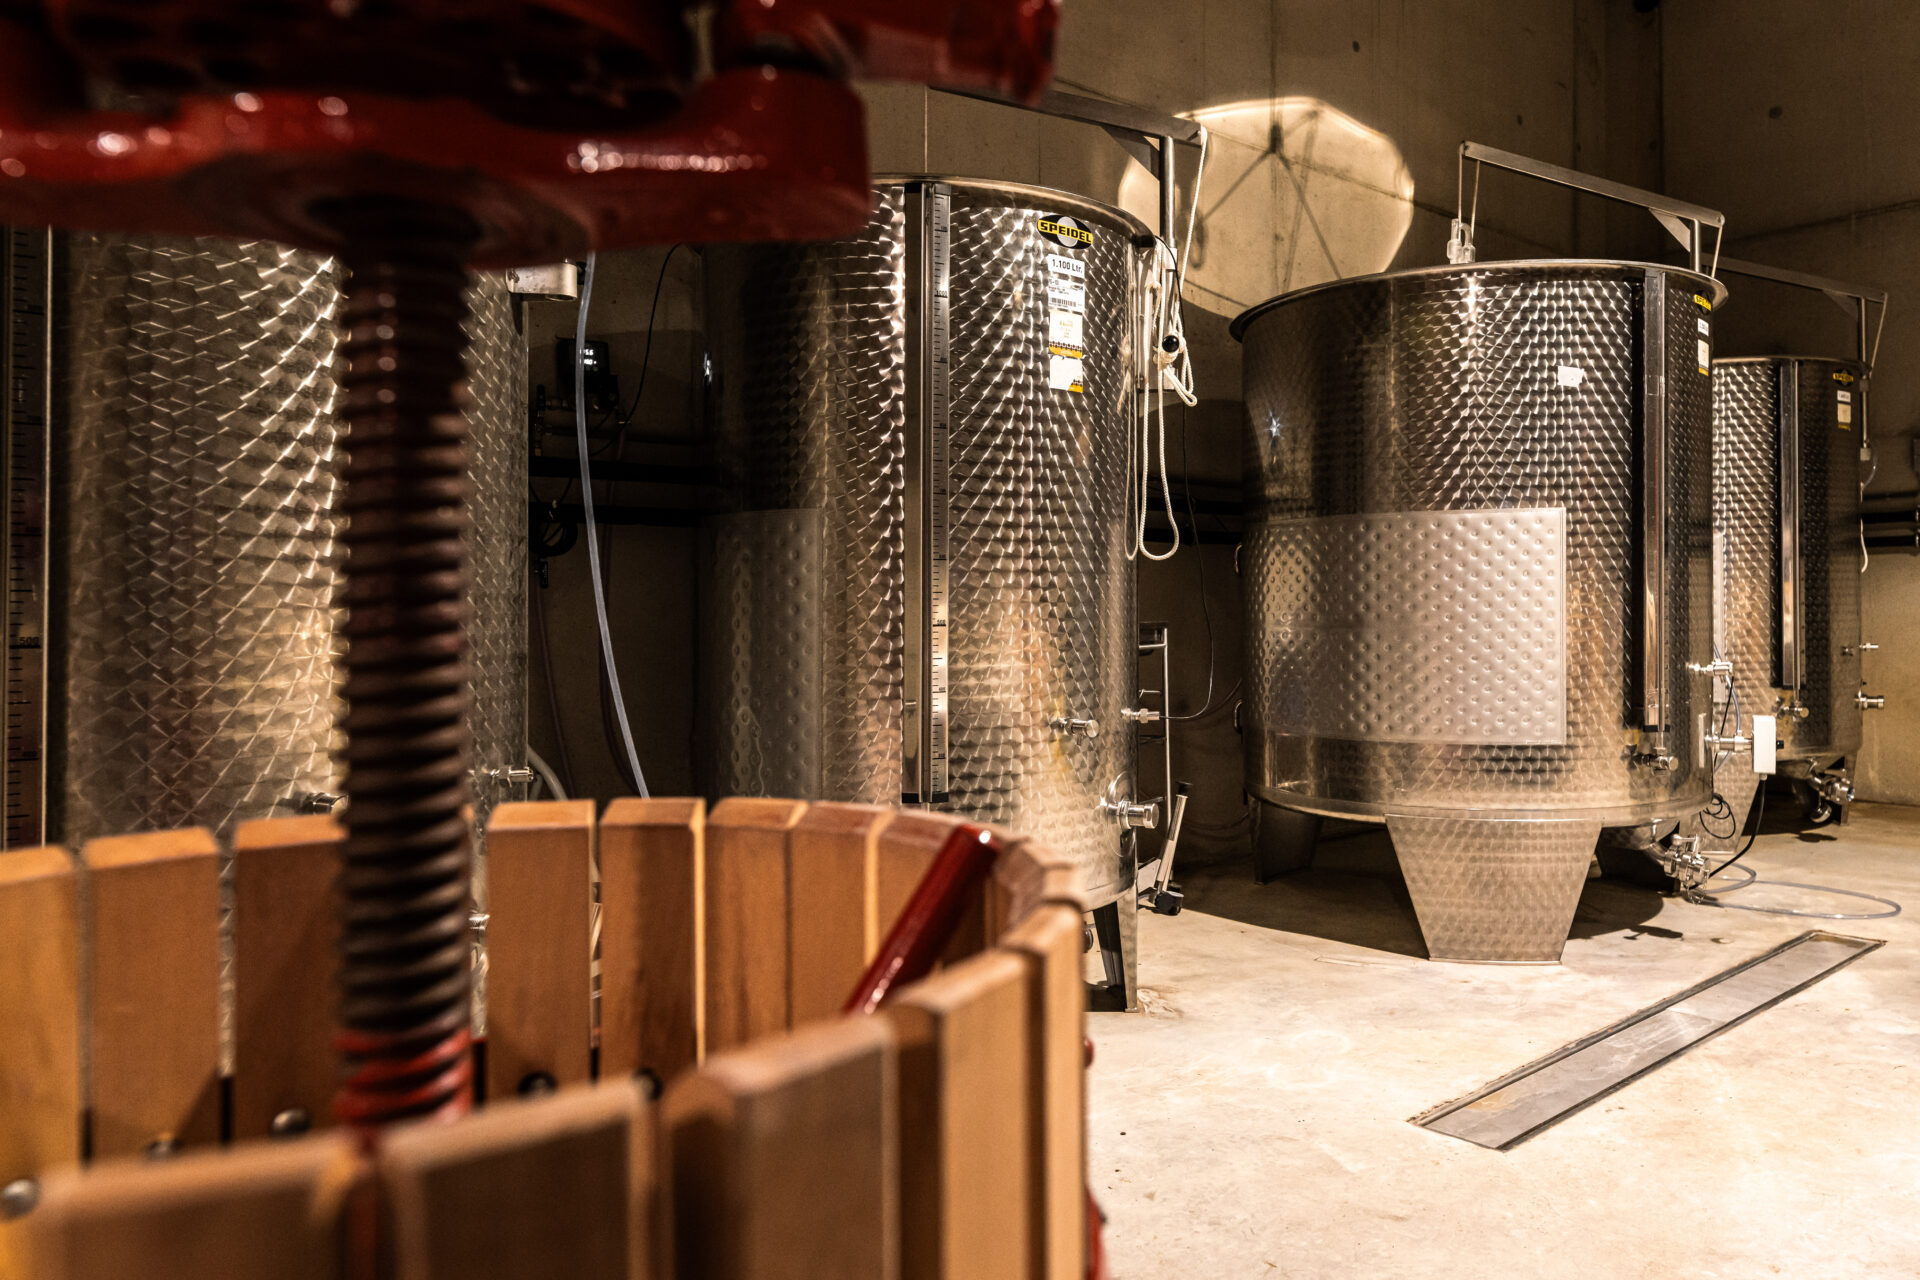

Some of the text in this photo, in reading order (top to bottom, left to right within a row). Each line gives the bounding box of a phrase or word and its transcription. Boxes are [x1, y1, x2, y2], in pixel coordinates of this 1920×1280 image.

[1040, 221, 1092, 243] SPEIDEL
[1052, 259, 1083, 273] 1.100 Ltr.
